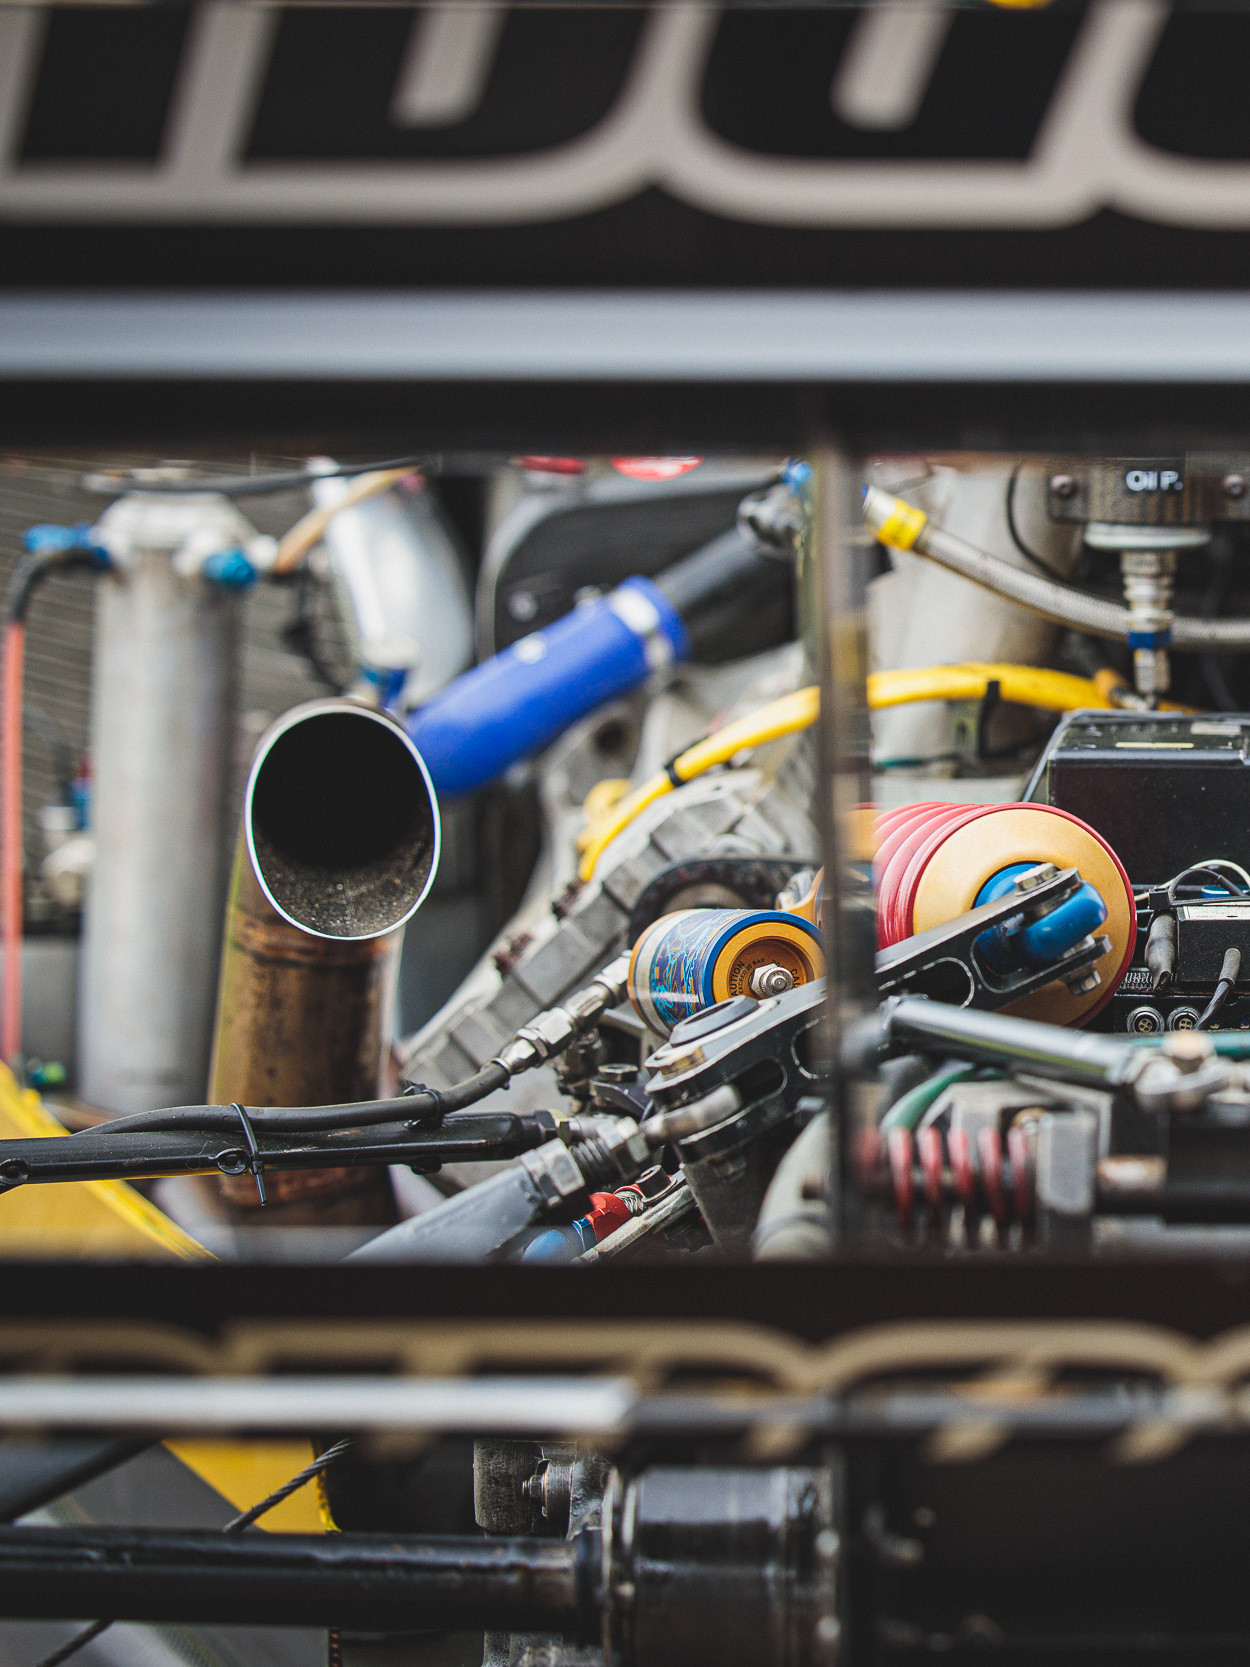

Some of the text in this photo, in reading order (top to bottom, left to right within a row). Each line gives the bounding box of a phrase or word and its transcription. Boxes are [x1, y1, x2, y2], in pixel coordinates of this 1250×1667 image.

[1125, 470, 1183, 491] Oil P.
[730, 960, 746, 996] AUTION
